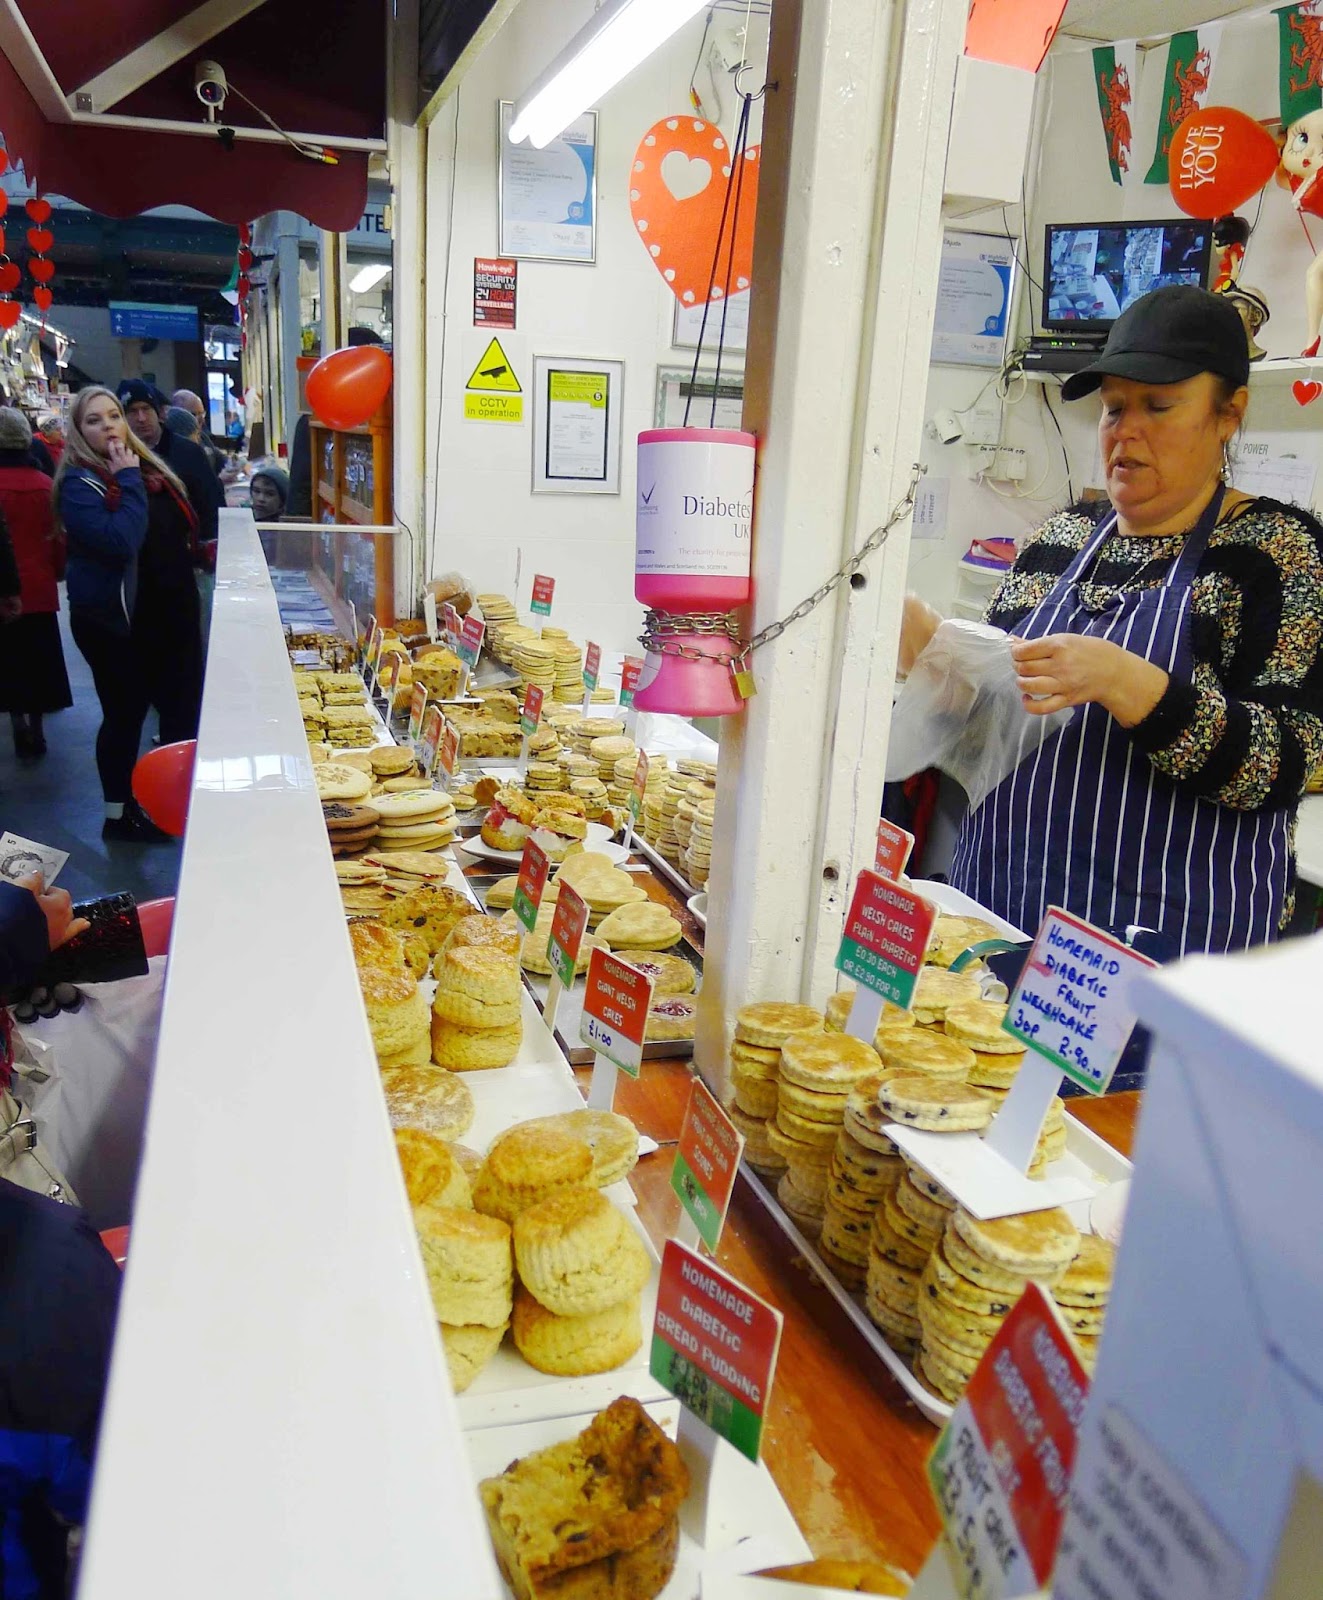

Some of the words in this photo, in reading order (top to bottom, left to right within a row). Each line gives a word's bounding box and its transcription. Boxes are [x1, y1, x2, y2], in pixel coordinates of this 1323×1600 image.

[1180, 126, 1204, 180] LOVE
[1194, 126, 1225, 189] YOU!
[476, 274, 516, 284] SECURITY
[476, 281, 502, 289] SYSTEMS
[476, 288, 490, 300] 24
[490, 290, 514, 302] HOUR
[478, 409, 520, 418] operation
[480, 398, 508, 408] CCTV
[1243, 443, 1269, 455] POWER
[682, 496, 750, 518] Diabetes
[734, 524, 750, 539] UK
[872, 883, 916, 916] HOMEMADE
[862, 904, 888, 926] WELSH
[887, 919, 915, 942] CAKES
[1046, 924, 1120, 976] HOMEMAID
[604, 958, 638, 988] HOMEMADE
[877, 958, 897, 978] EACH
[1046, 954, 1108, 999] DIABETIC
[843, 959, 854, 970] OR
[875, 978, 890, 994] FOR
[891, 988, 901, 1000] 10
[616, 992, 637, 1011] WELSH
[602, 1006, 624, 1027] CAKES
[681, 1260, 754, 1326] HOMEMADE
[656, 1310, 699, 1354] BREAD
